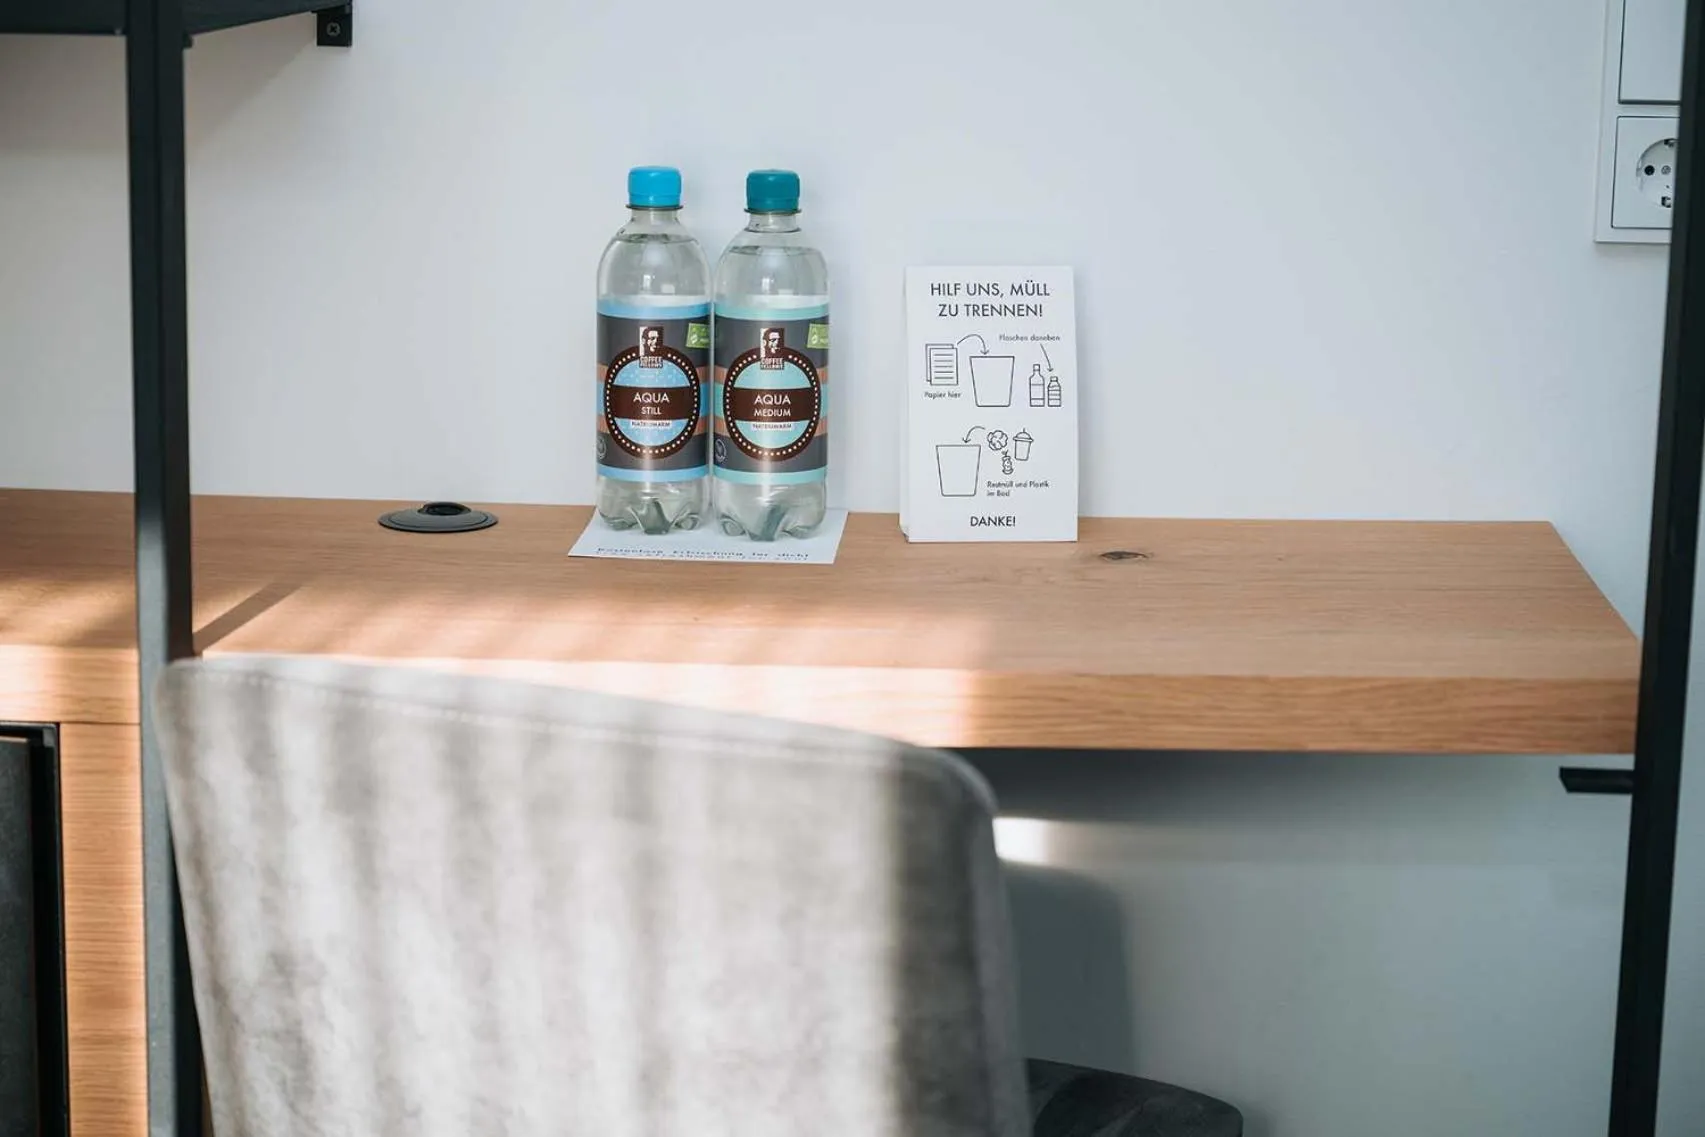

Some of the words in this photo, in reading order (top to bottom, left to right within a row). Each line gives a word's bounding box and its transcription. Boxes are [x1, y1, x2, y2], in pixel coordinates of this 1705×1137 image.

[930, 283, 961, 296] HILF
[966, 283, 1004, 298] UNS,
[1010, 280, 1050, 296] MÜLL
[938, 304, 959, 317] ZU
[964, 304, 1043, 317] TRENNEN!
[633, 392, 670, 403] AQUA
[754, 394, 791, 405] AQUA
[924, 391, 946, 399] Papier
[641, 407, 661, 415] STILL
[970, 516, 1016, 527] DANKE!
